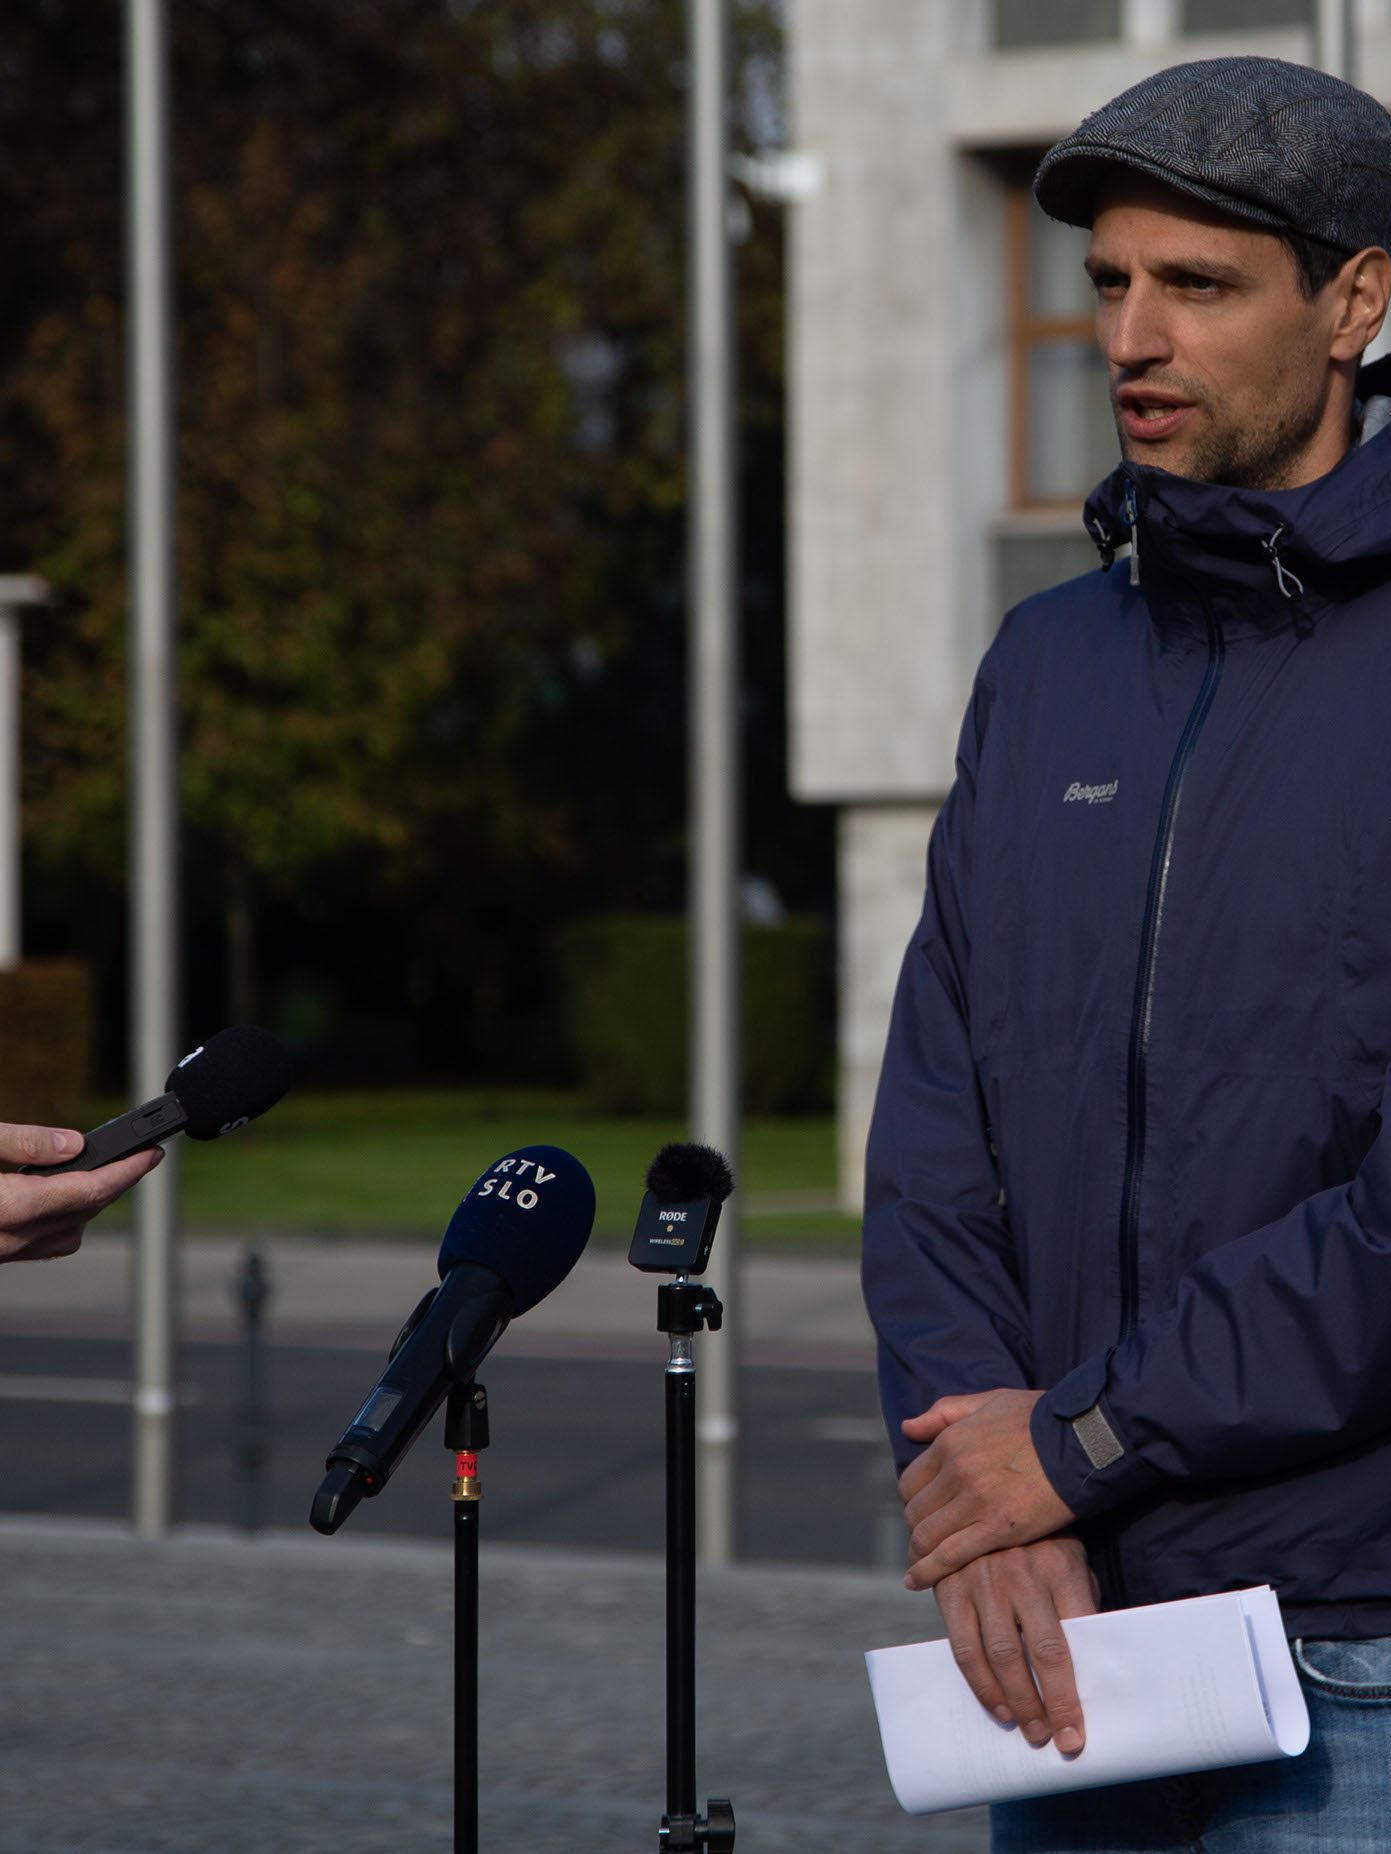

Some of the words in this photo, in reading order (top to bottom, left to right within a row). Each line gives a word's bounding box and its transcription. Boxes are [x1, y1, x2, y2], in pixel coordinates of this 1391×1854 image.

[1063, 779, 1119, 805] Bergans
[493, 1158, 557, 1185] RTV
[477, 1178, 539, 1210] SLO
